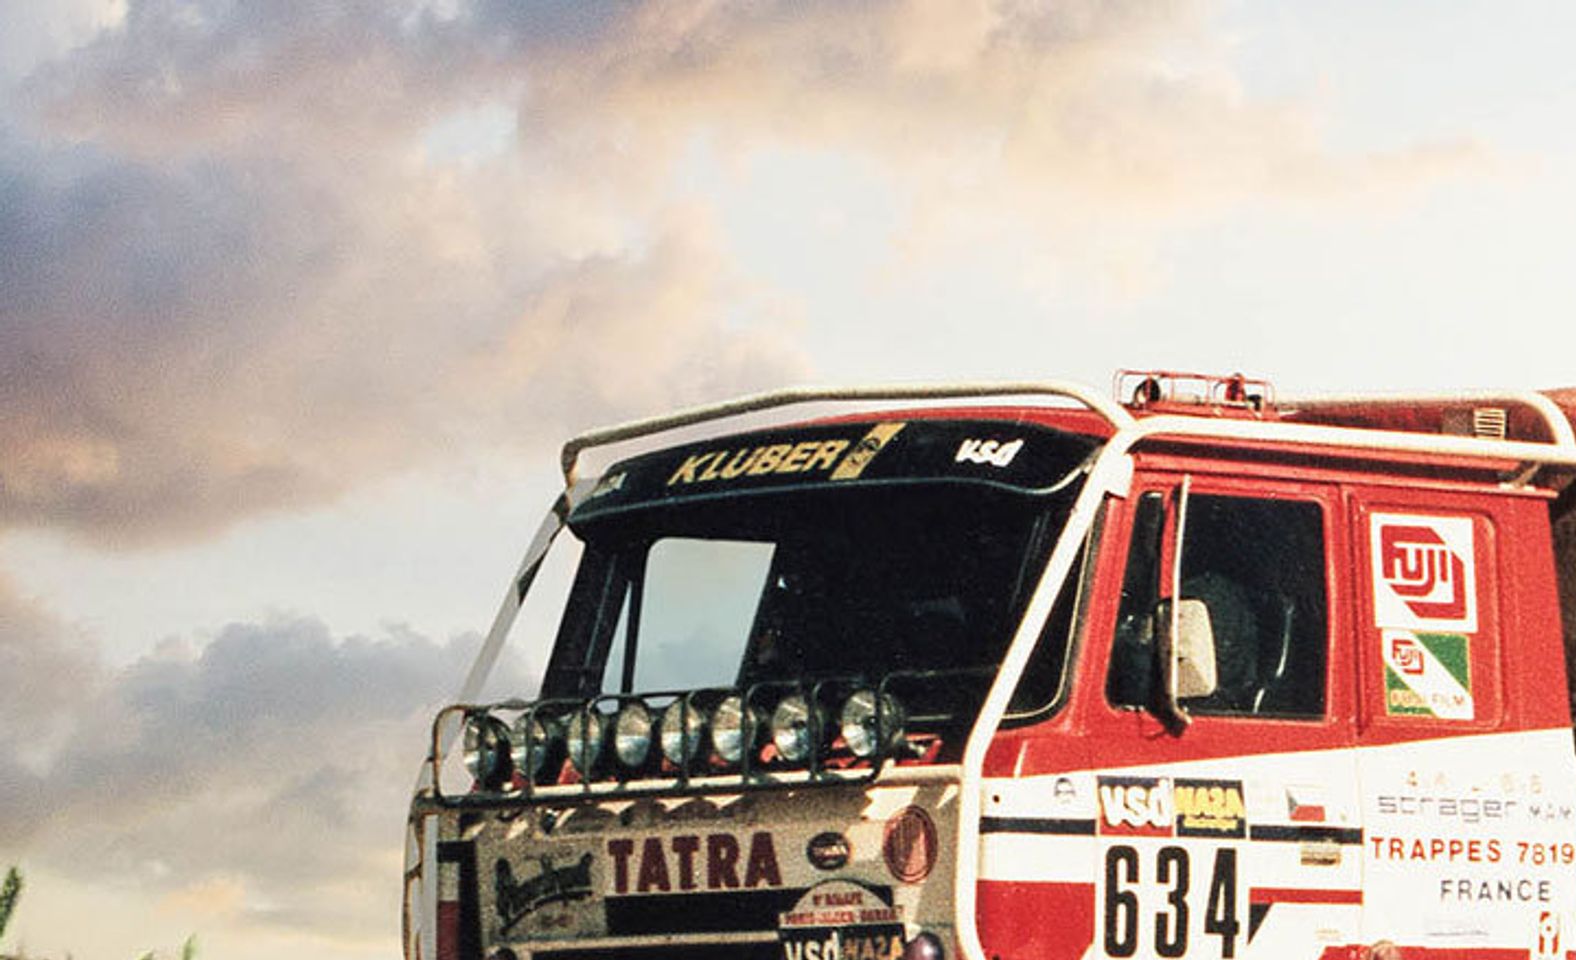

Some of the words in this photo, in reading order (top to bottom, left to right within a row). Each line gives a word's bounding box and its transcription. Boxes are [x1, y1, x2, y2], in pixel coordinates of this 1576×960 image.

[667, 439, 849, 487] KLUBER
[1381, 524, 1456, 605] FUJI
[1099, 778, 1171, 827] vsd
[607, 831, 784, 895] TATRA
[1370, 836, 1502, 863] TRAPPES
[1102, 844, 1241, 960] 634
[1440, 879, 1552, 902] FRANCE
